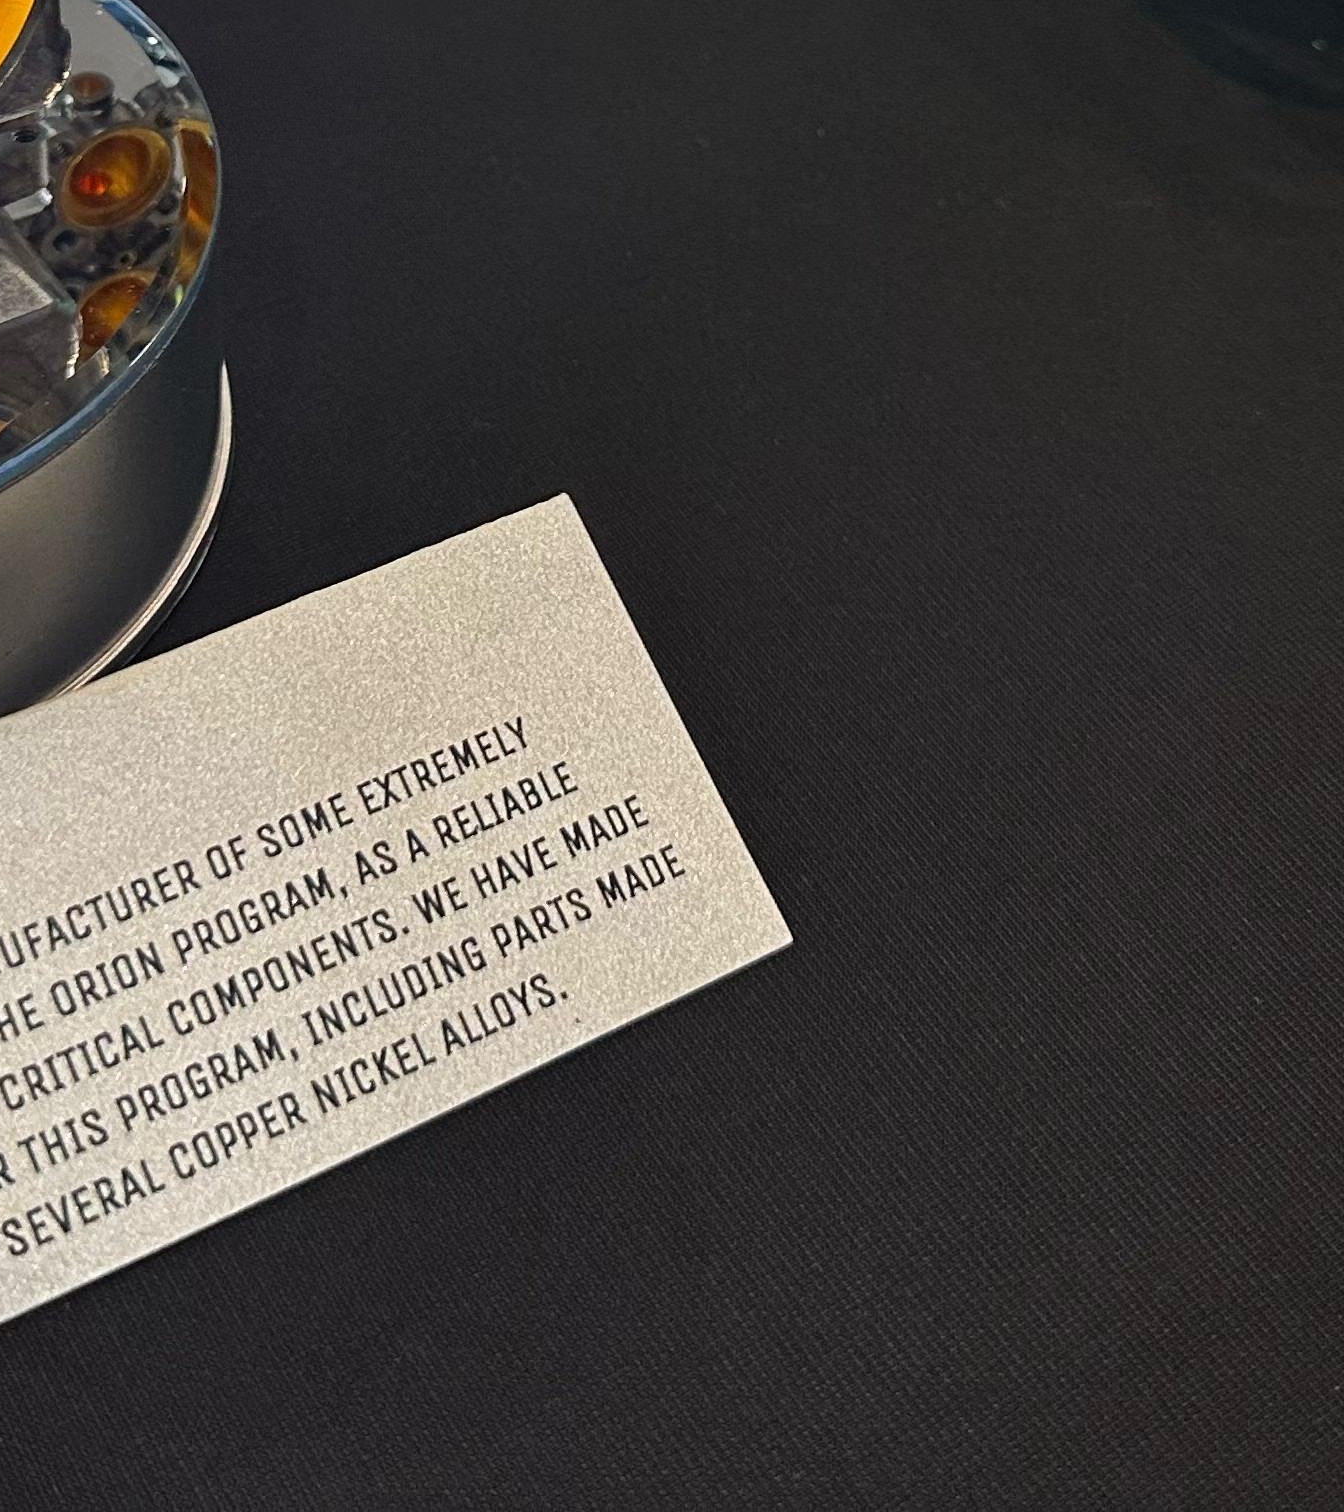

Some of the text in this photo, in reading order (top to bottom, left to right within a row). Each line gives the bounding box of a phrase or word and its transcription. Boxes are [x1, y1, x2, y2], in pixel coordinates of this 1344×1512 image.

[44, 937, 165, 1015] ORION
[168, 859, 348, 962] PROGRAM,
[348, 837, 400, 883] AS
[397, 824, 430, 862] A
[429, 761, 579, 848] RELIABLE
[163, 900, 409, 1034] COMPONENTS.
[410, 874, 468, 924] WE
[468, 835, 558, 898] HAVE
[558, 795, 650, 858] MADE
[201, 832, 254, 880] OF
[252, 790, 355, 858] SOME
[354, 716, 533, 815] EXTREMELY
[14, 1103, 109, 1173] THIS
[112, 1017, 300, 1129] PROGRAM,
[299, 933, 488, 1043] INCLUDING
[487, 885, 594, 958] PARTS
[591, 843, 687, 910] MADE
[164, 1087, 306, 1179] COPPER
[307, 1027, 437, 1112] NICKEL
[433, 967, 568, 1054] ALLOYS.
